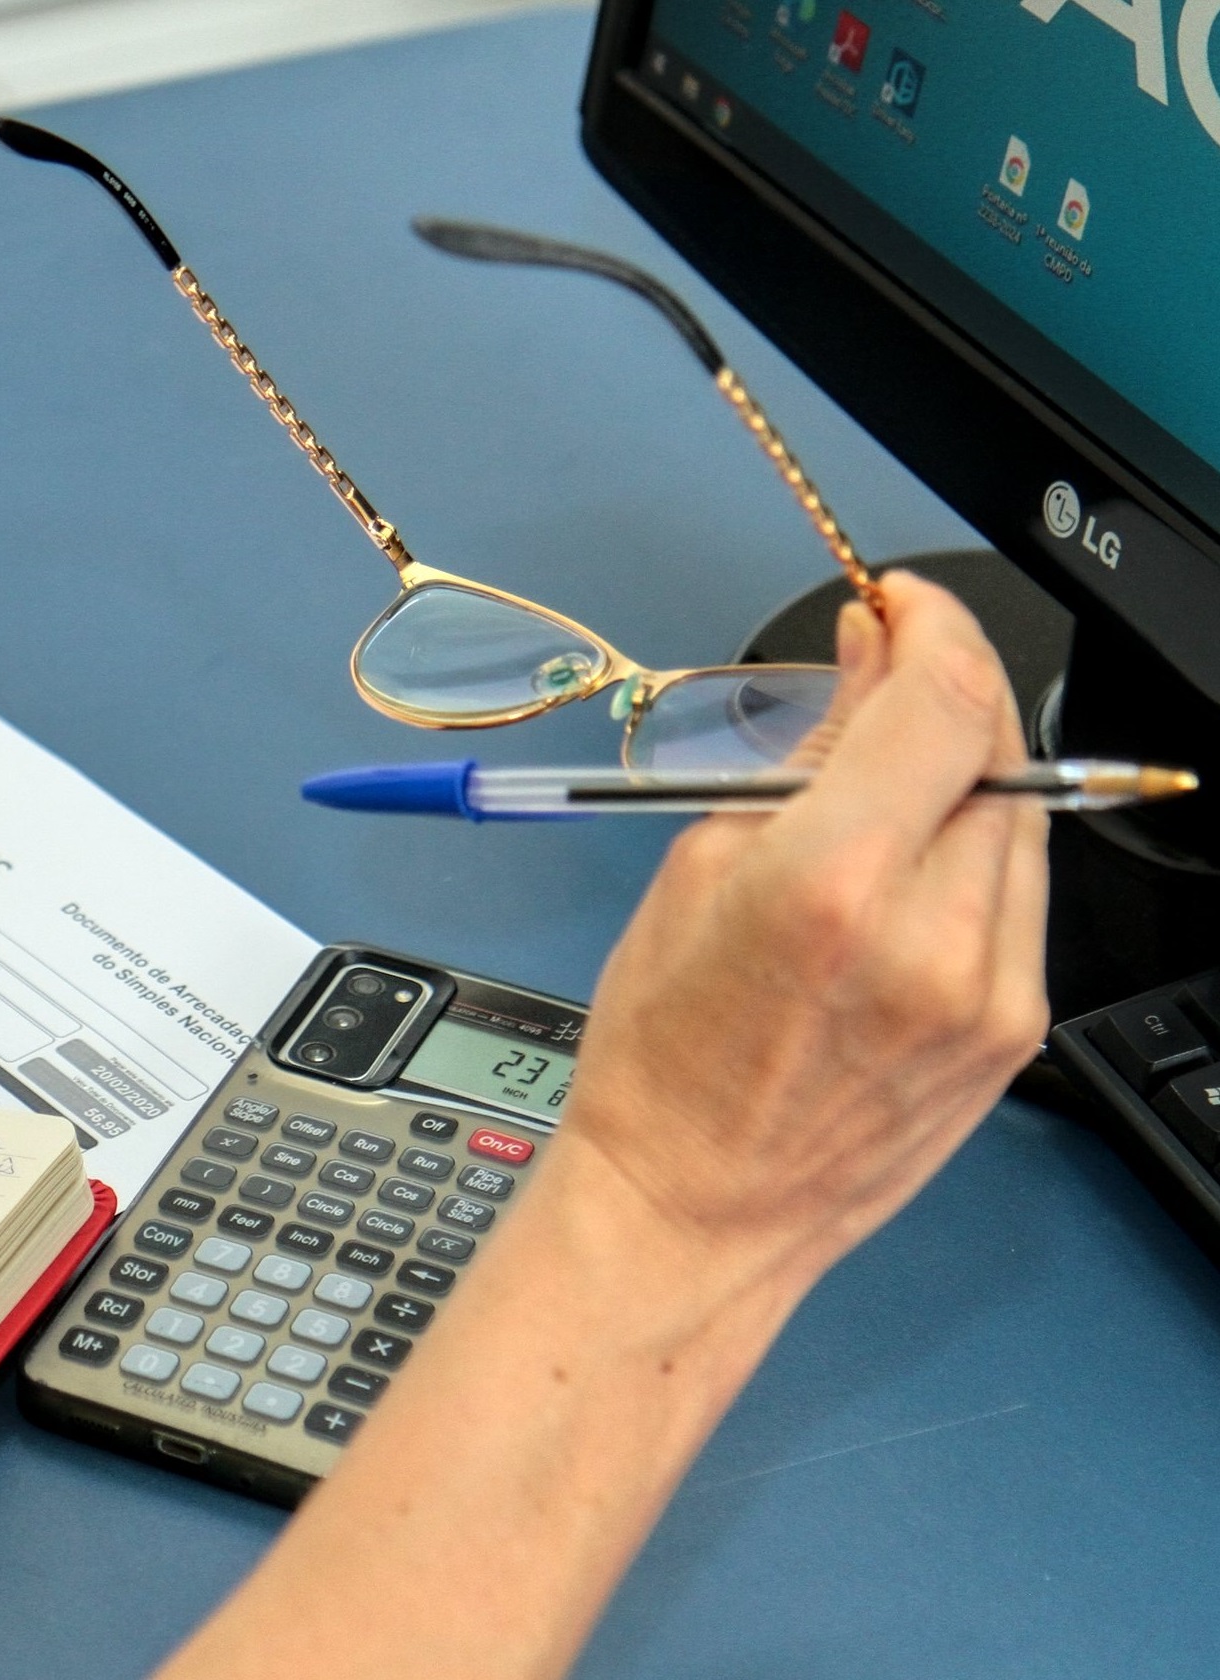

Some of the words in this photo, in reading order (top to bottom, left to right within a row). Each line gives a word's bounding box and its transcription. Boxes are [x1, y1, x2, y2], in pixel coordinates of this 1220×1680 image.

[1080, 258, 1092, 275] da
[1082, 515, 1121, 570] LG
[61, 903, 148, 968] Documento
[148, 964, 171, 985] de
[92, 952, 116, 970] do
[115, 969, 179, 1017] Simples
[1144, 1015, 1169, 1036] Ctrl
[492, 1050, 550, 1085] 23
[90, 1064, 162, 1117] 20/02/2020
[502, 1086, 529, 1100] INCH
[83, 1107, 124, 1137] 56,95
[228, 1106, 265, 1125] Slope
[289, 1119, 328, 1138] Offset
[422, 1118, 446, 1132] Off
[354, 1138, 380, 1153] Run
[479, 1135, 524, 1156] On/C
[274, 1151, 301, 1166] Sine
[412, 1155, 439, 1170] Run
[333, 1169, 360, 1184] Cos
[473, 1169, 504, 1186] Pipe
[393, 1186, 419, 1201] Cos
[172, 1196, 201, 1211] mm
[305, 1198, 345, 1217] Circle
[453, 1199, 484, 1217] Pipe
[229, 1213, 261, 1229] Feet
[447, 1208, 474, 1223] Size
[366, 1215, 405, 1236] Circle
[142, 1226, 185, 1247] Conv
[289, 1230, 320, 1247] Inch
[213, 1247, 234, 1263] 7
[348, 1249, 381, 1266] Inch
[120, 1262, 157, 1283] Stor
[272, 1263, 292, 1281] 8
[187, 1283, 209, 1300] 4
[333, 1281, 353, 1299] 8
[98, 1298, 130, 1317] Rcl
[247, 1299, 268, 1317] 5
[308, 1318, 329, 1337] 5
[72, 1333, 103, 1351] M+
[223, 1336, 245, 1353] 2
[138, 1353, 158, 1373] 0
[285, 1355, 307, 1374] 2
[123, 1381, 197, 1408] CALCULATED
[201, 1403, 268, 1432] INDUSTRIES
